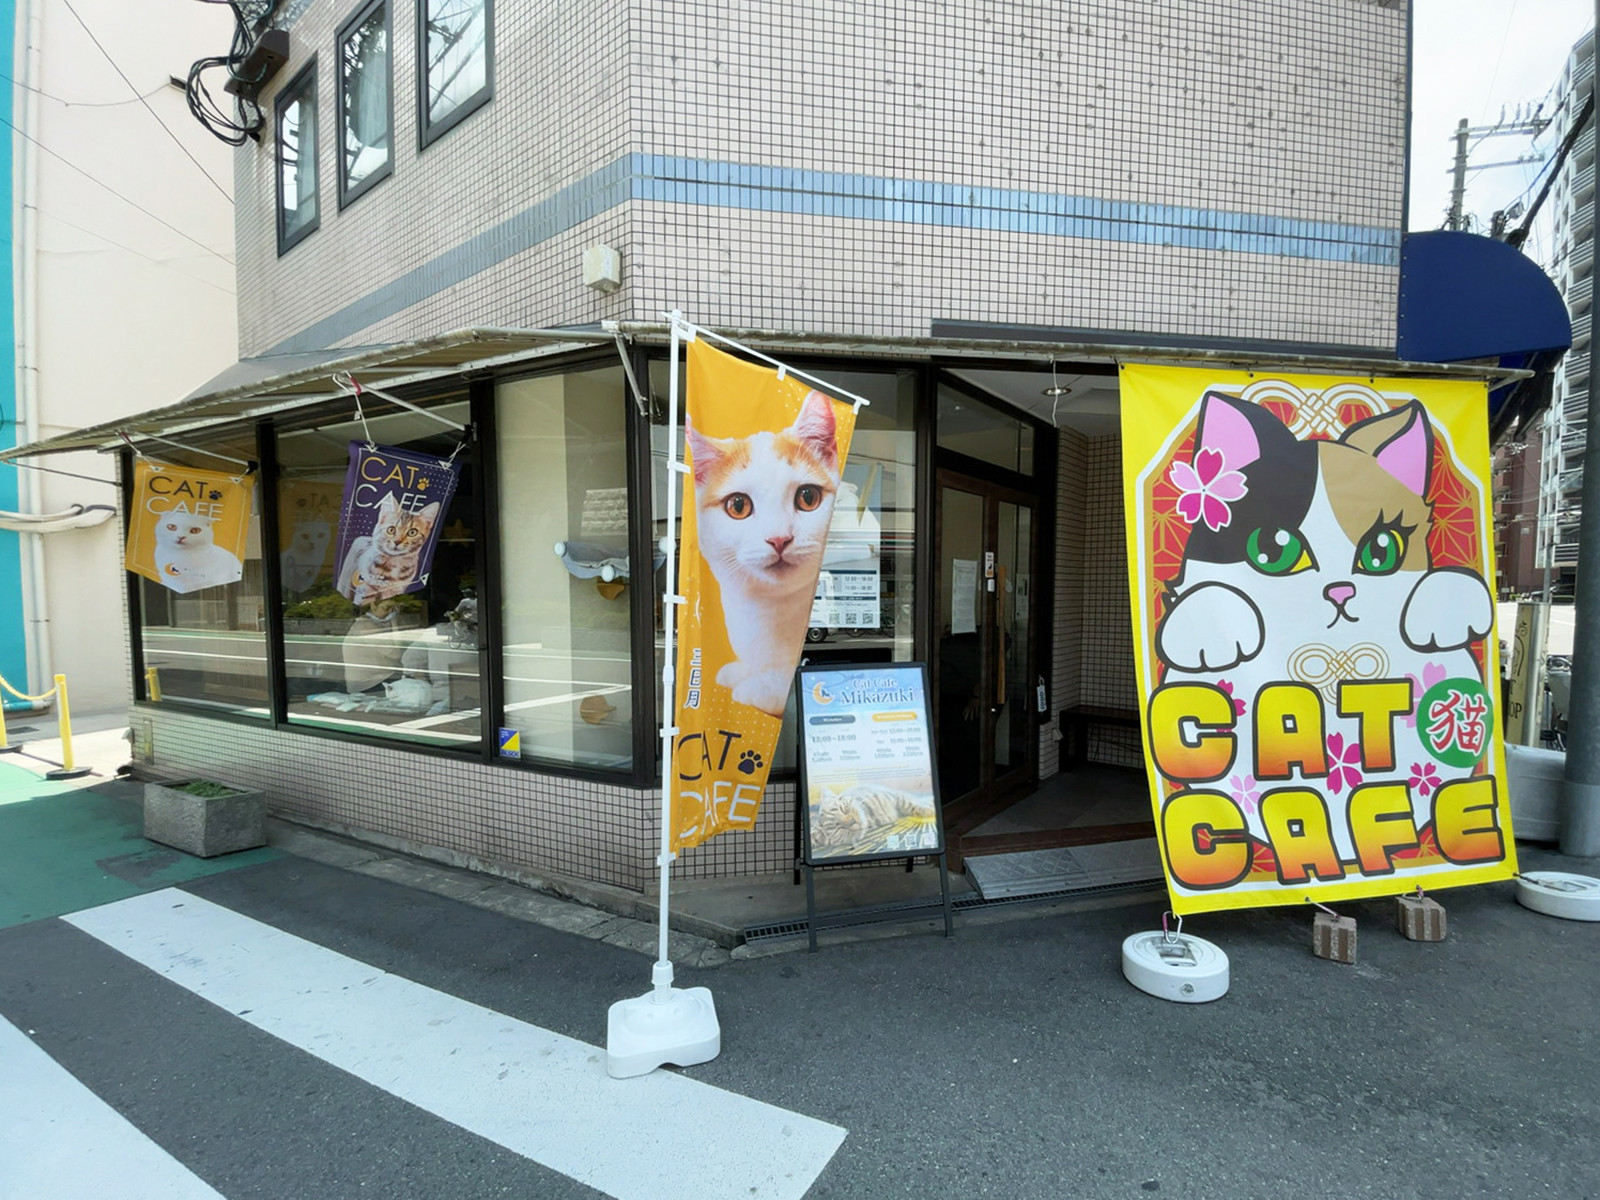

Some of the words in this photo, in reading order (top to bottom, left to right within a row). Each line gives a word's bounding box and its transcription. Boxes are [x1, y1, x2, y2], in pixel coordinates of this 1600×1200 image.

[149, 475, 208, 499] CAT
[361, 456, 420, 489] CAT
[146, 496, 224, 521] CAFE
[355, 483, 427, 516] CAFE
[841, 688, 914, 705] Mikazuki
[853, 679, 870, 689] Cat
[1147, 678, 1413, 782] CAT
[1428, 689, 1487, 755] 猫
[678, 730, 742, 780] CAT
[680, 781, 761, 838] CAFE
[1160, 774, 1506, 891] CAFE
